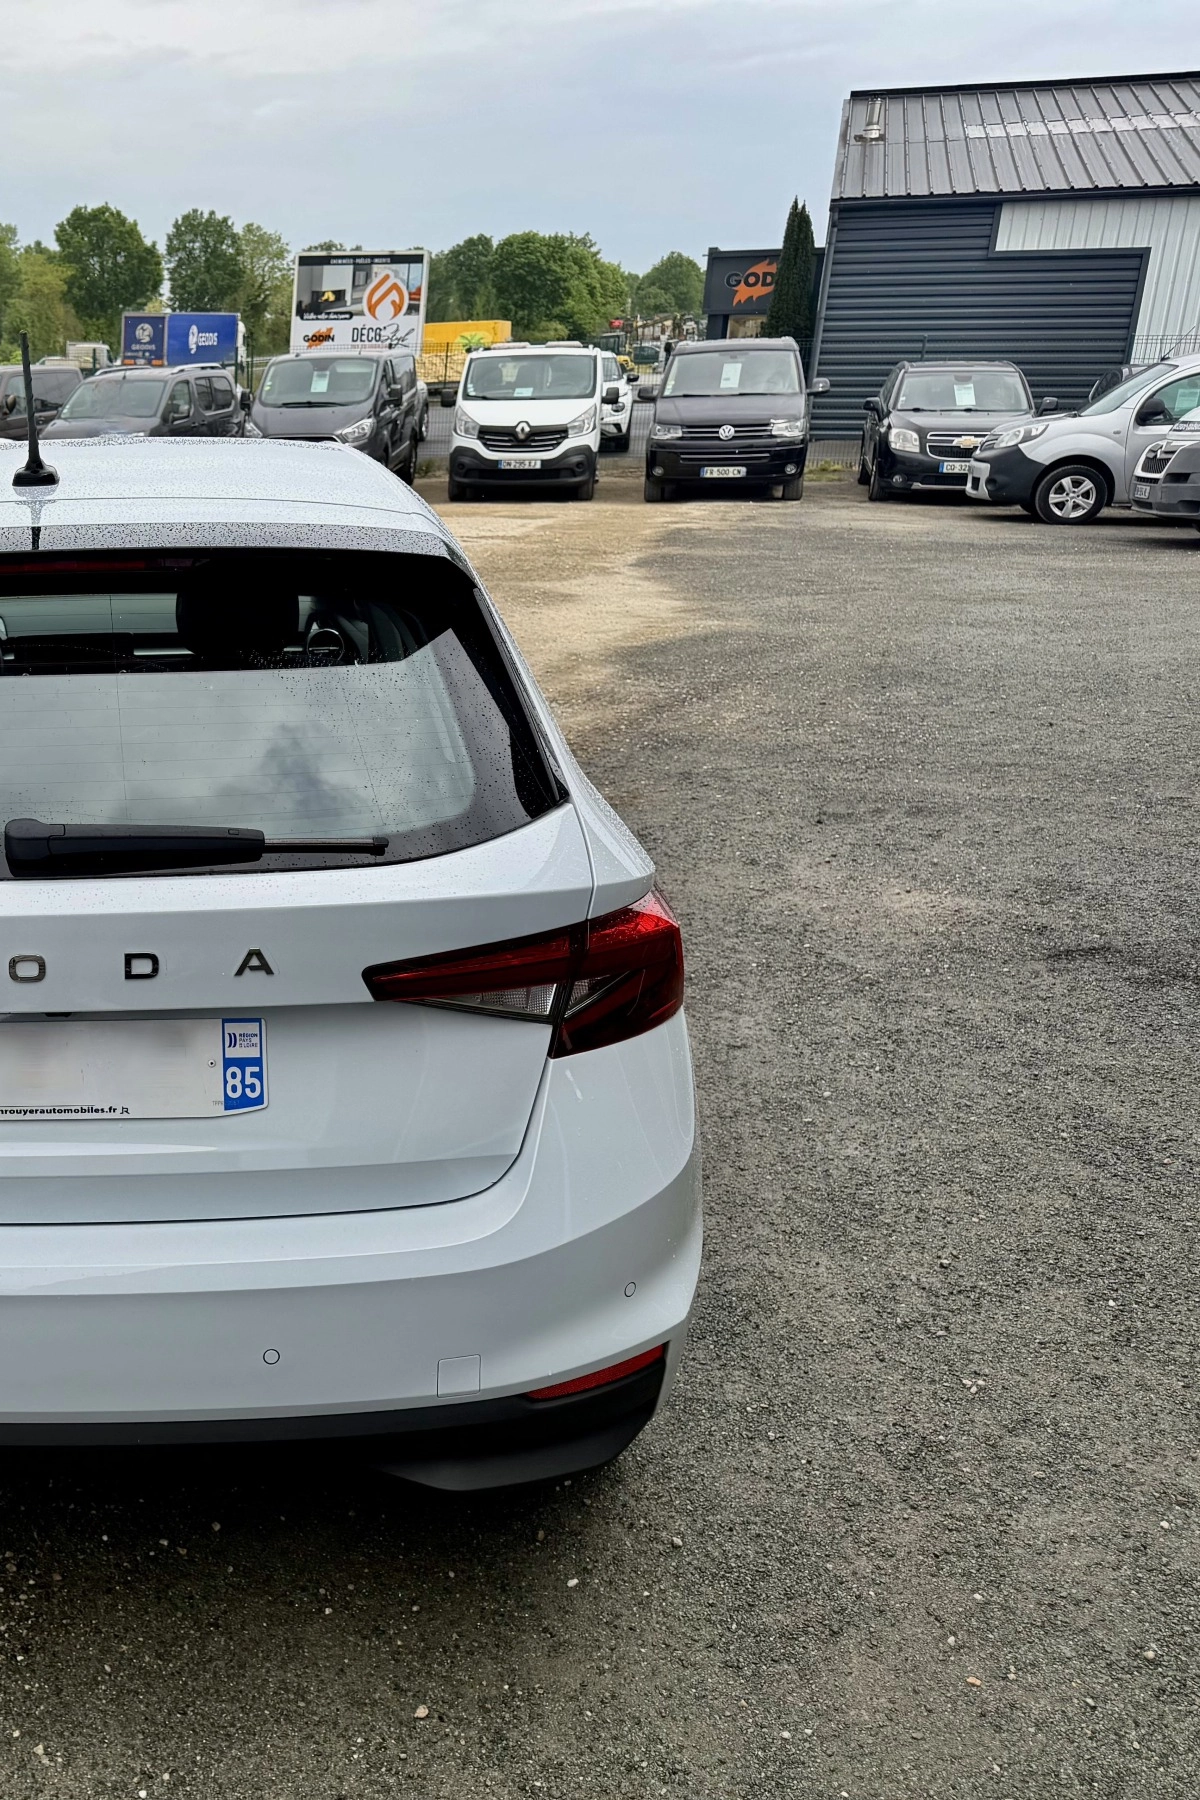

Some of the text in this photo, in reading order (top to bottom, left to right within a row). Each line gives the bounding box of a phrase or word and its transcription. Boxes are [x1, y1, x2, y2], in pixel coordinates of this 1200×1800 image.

[724, 271, 776, 288] GOD
[198, 332, 218, 346] GEODIS
[303, 334, 335, 342] GODIN
[131, 343, 156, 351] GEODIS
[225, 1066, 262, 1099] 85
